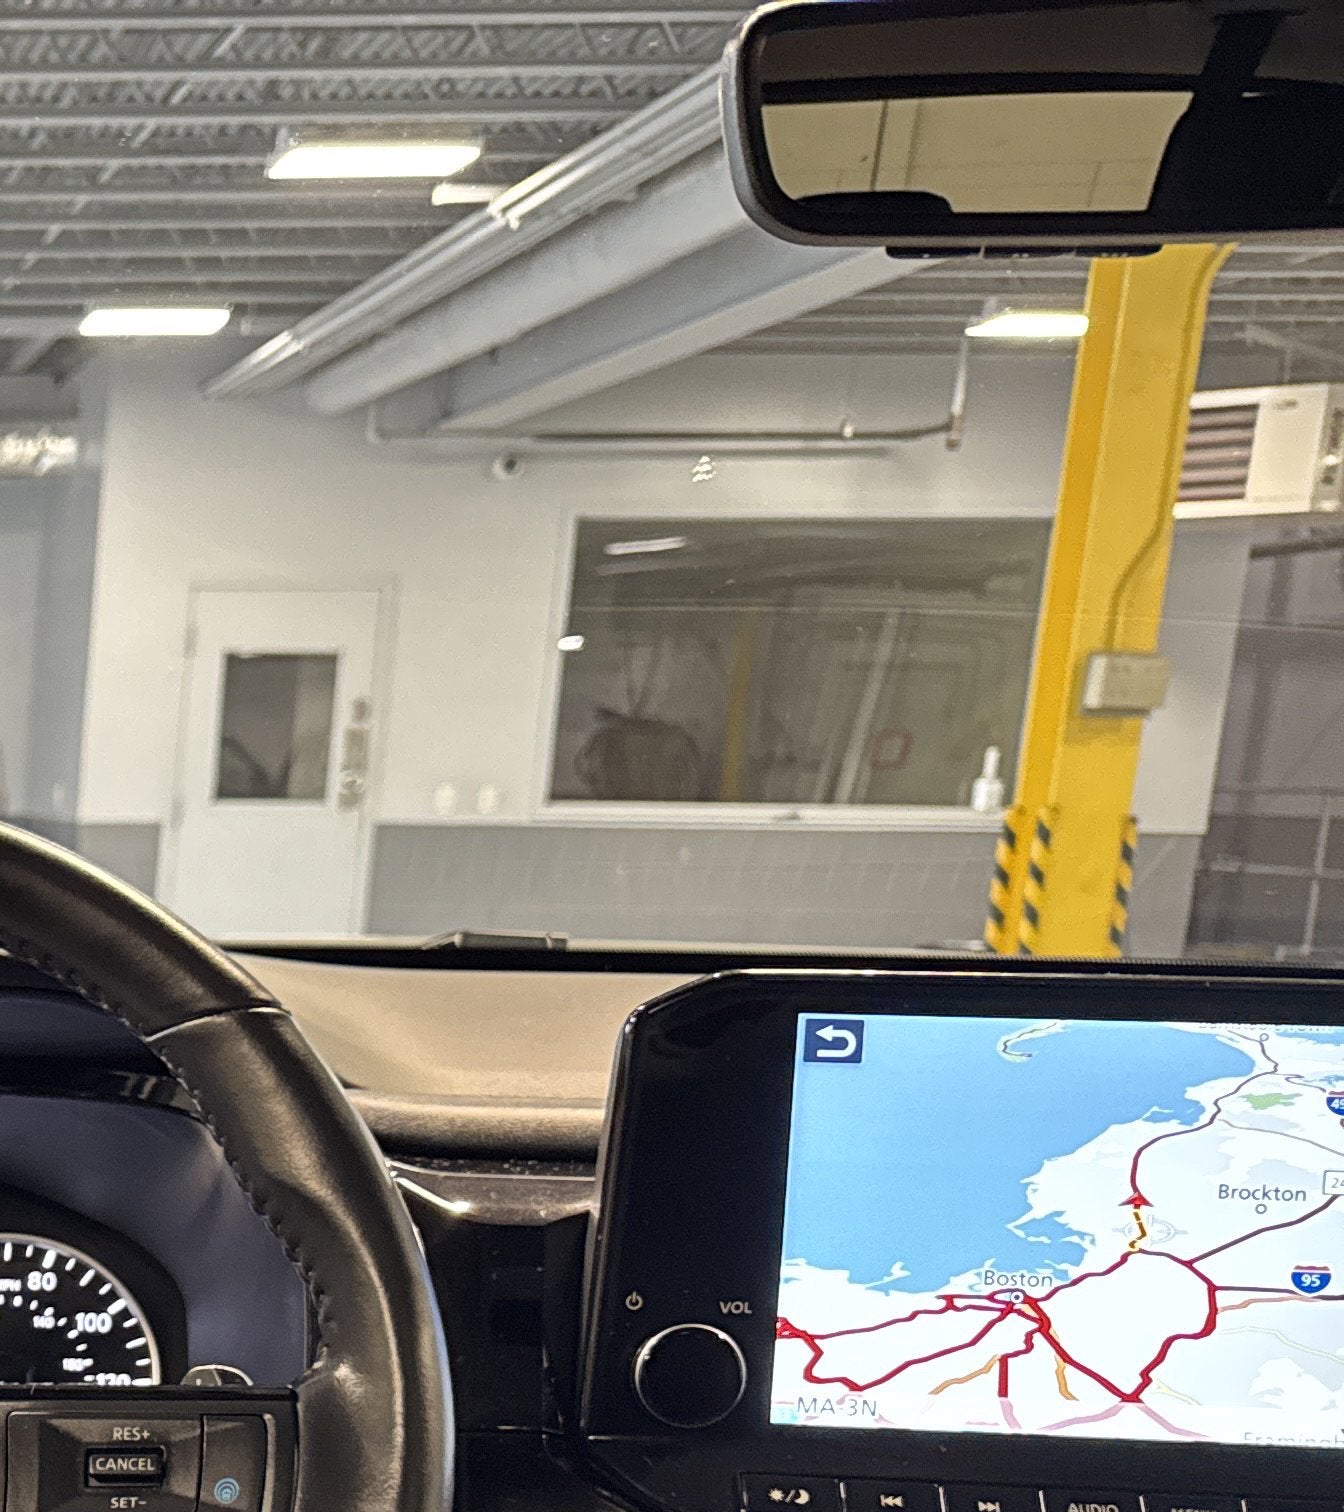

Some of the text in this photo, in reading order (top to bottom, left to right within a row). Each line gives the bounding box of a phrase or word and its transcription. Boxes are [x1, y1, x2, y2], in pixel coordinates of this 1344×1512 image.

[1218, 1183, 1307, 1202] Brockton
[27, 1270, 58, 1292] 80
[983, 1269, 1053, 1287] Boston
[1300, 1274, 1321, 1287] 95
[719, 1301, 752, 1315] VOL
[75, 1311, 113, 1334] 100
[796, 1396, 878, 1417] MA-3N
[112, 1426, 151, 1441] RES+
[95, 1456, 156, 1471] CANCEL
